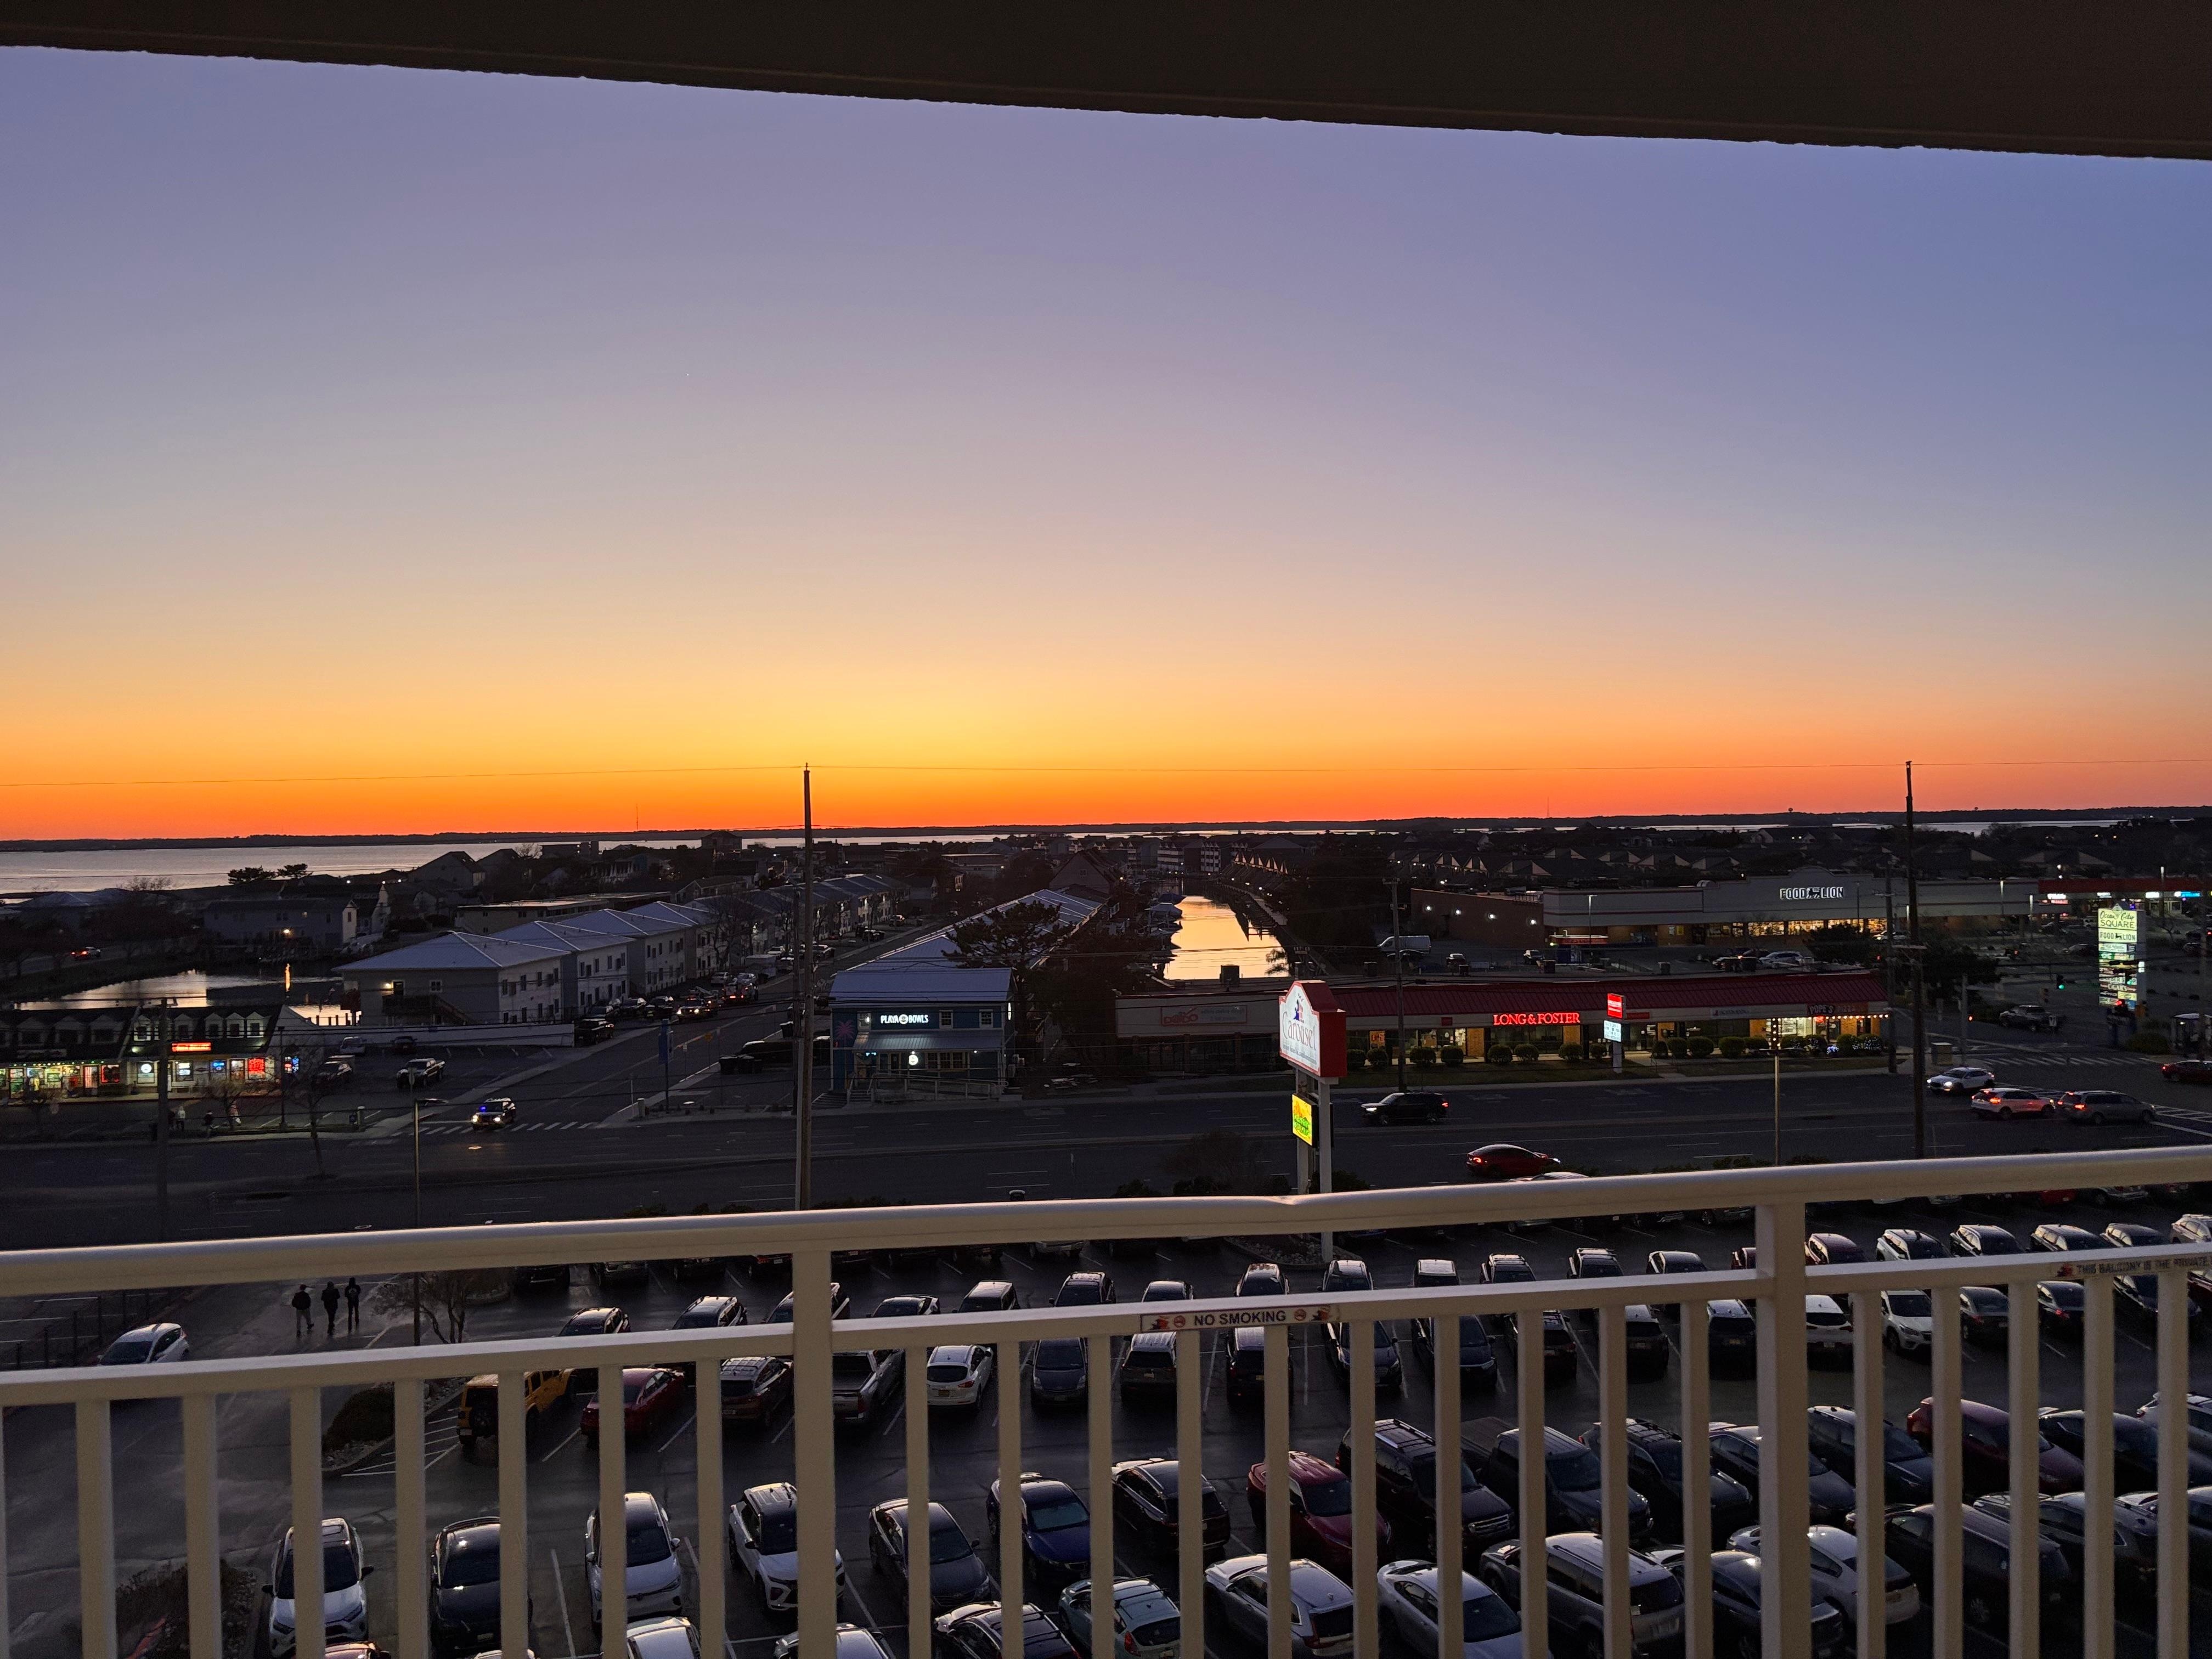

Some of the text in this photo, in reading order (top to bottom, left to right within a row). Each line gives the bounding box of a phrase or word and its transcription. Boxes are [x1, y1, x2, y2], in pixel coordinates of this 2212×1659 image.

[1780, 887, 1843, 900] FOOD LION
[2121, 912, 2135, 921] City
[2100, 919, 2135, 928] SQUARE
[881, 1014, 929, 1024] PLAYA BOWLS
[1493, 1014, 1527, 1025] LONG
[1537, 1012, 1580, 1024] FOSTER
[1282, 1011, 1317, 1051] Carousel
[1194, 1310, 1286, 1326] NO SMOKING
